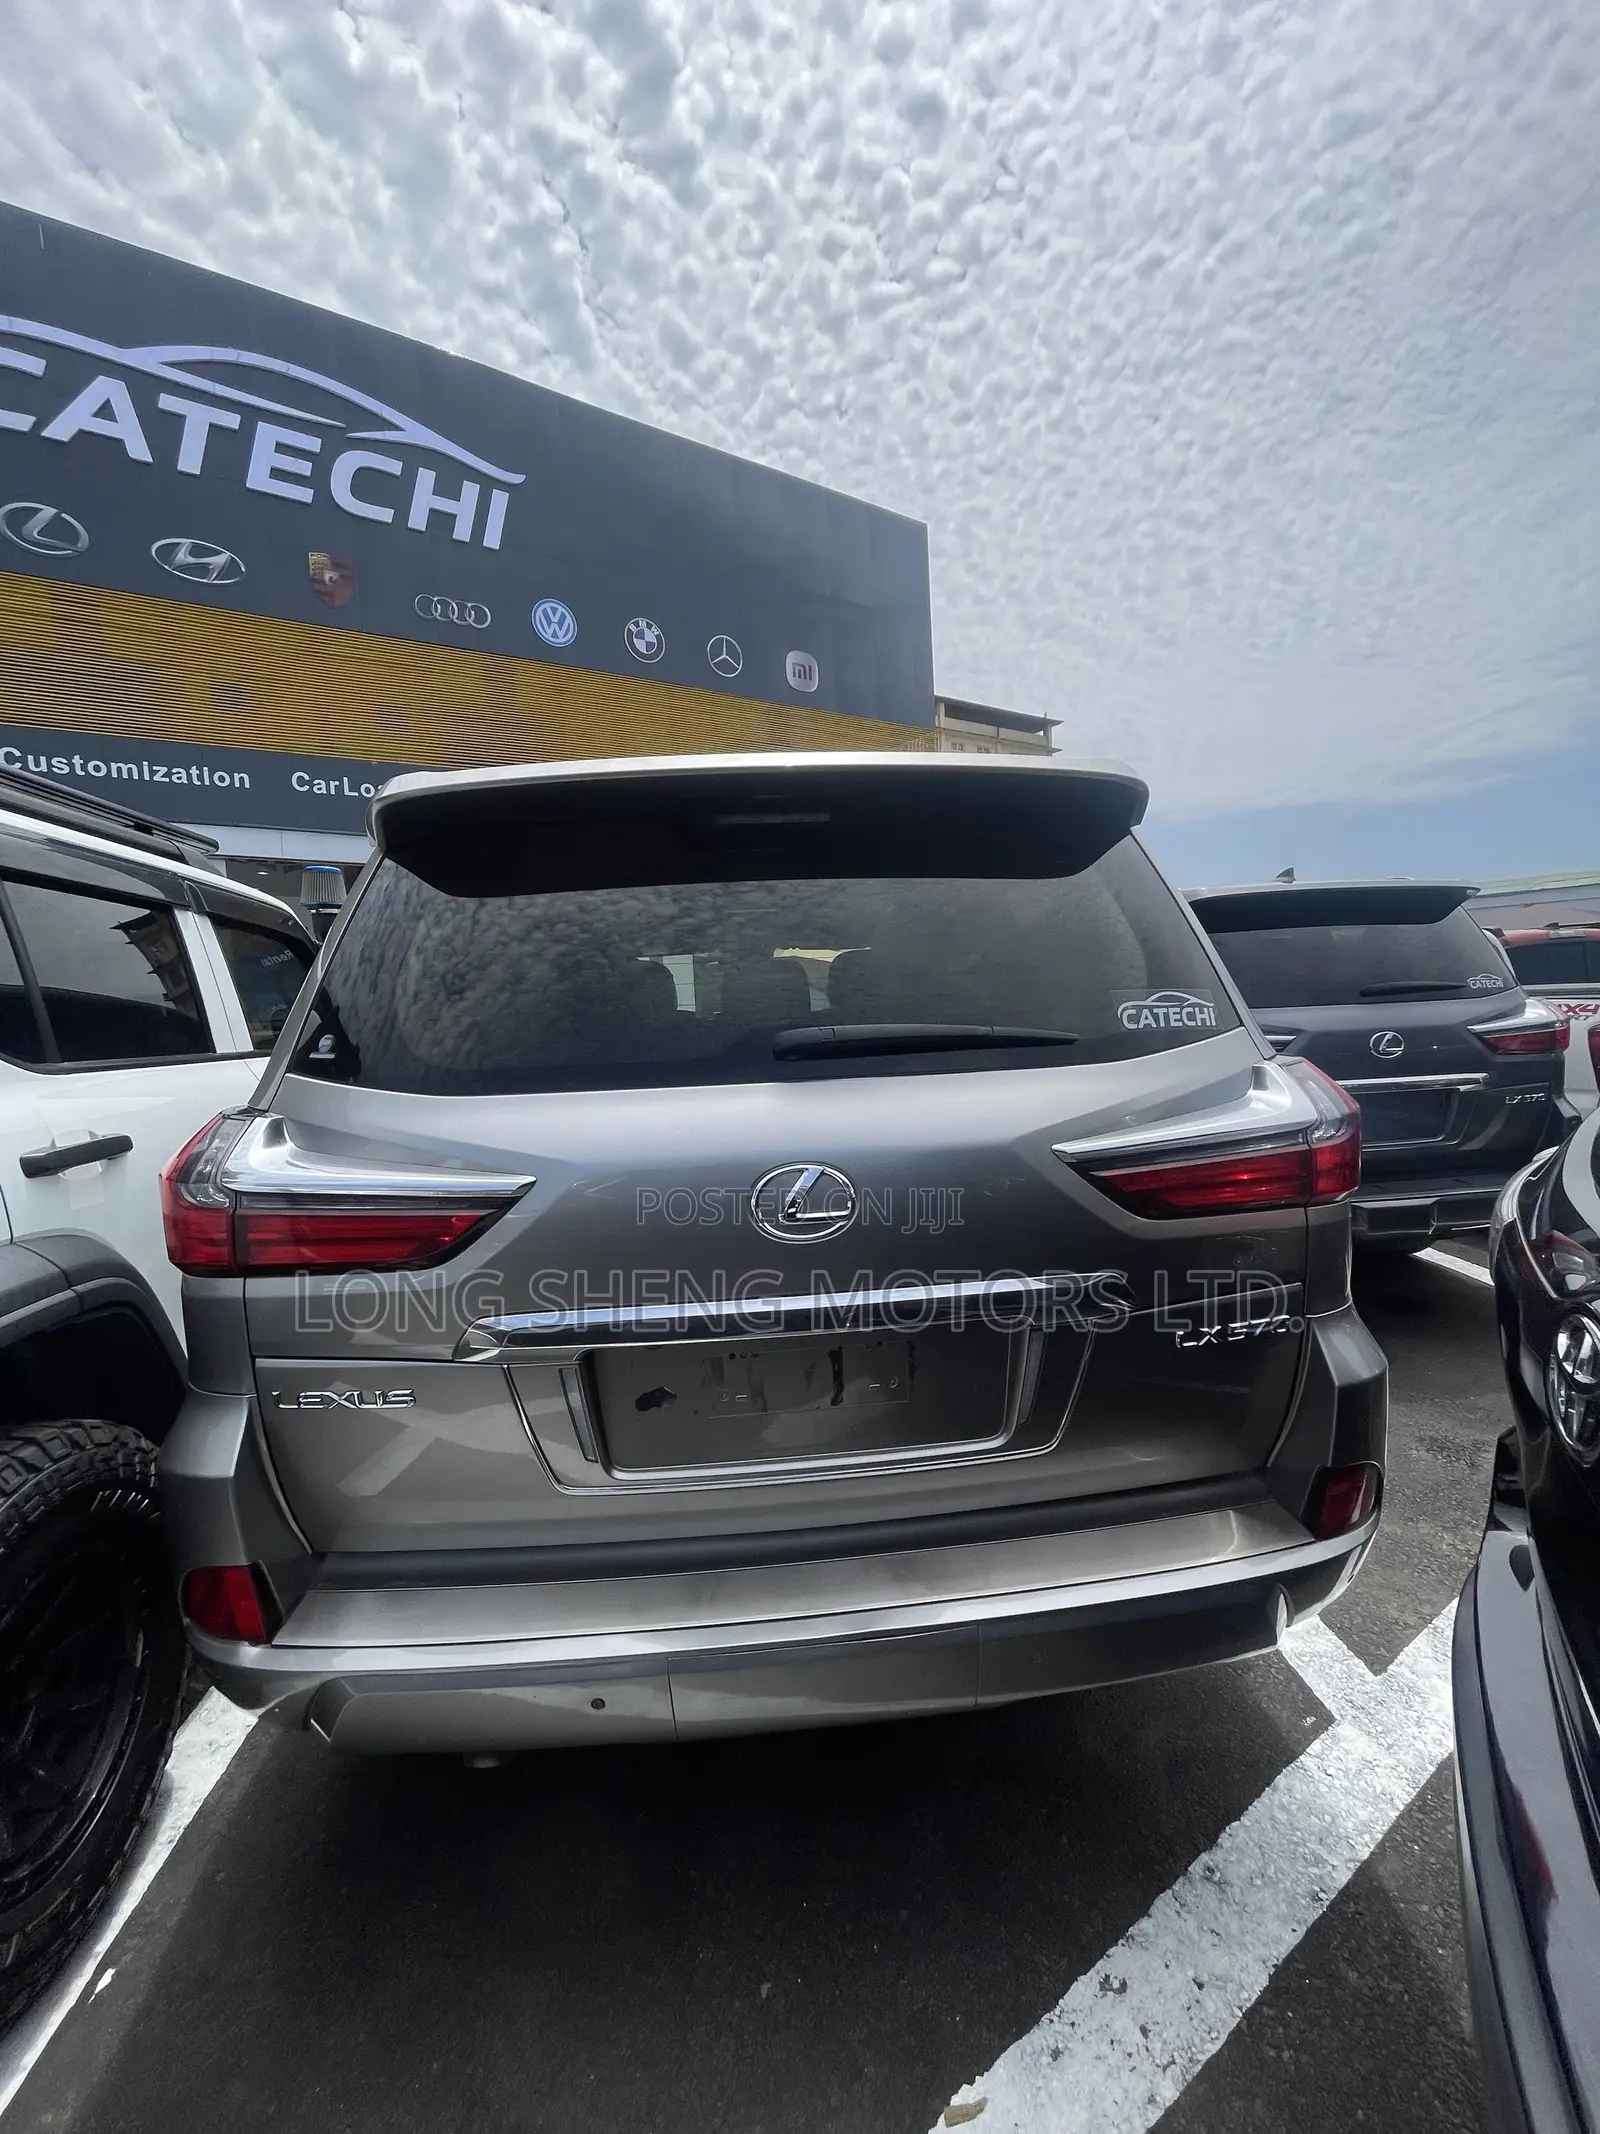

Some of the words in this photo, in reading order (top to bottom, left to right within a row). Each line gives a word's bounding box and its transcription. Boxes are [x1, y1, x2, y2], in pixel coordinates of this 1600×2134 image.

[0, 747, 250, 789] Customization
[291, 771, 383, 798] CarLo
[1469, 980, 1504, 989] CATECHI
[1121, 1005, 1216, 1030] CATECHI
[1175, 1325, 1222, 1348] LX
[271, 1388, 417, 1410] LEXUS
